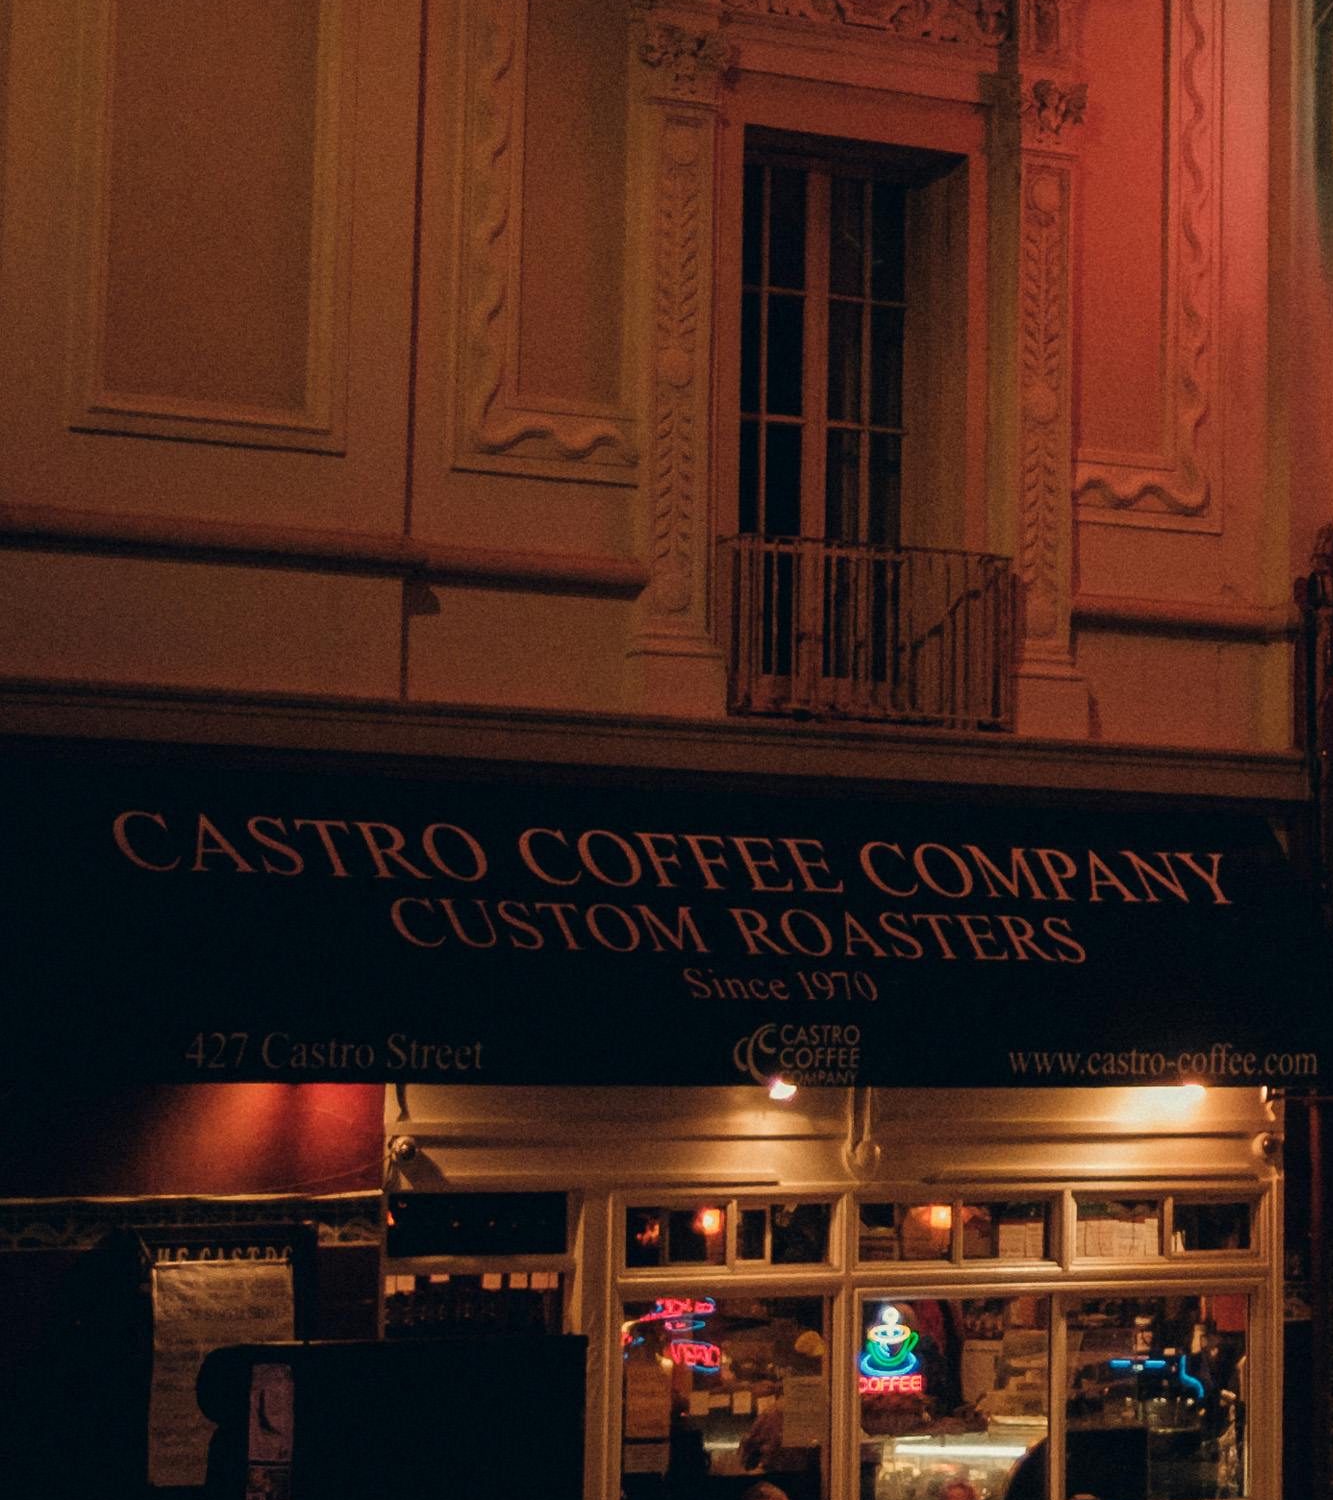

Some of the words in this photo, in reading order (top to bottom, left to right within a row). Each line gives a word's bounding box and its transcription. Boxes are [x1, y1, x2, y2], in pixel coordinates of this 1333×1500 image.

[112, 809, 489, 883] CASTRO
[517, 826, 844, 893] COFFEE
[859, 840, 1233, 905] COMPANY
[390, 896, 711, 953] CUSTOM
[730, 905, 1086, 965] ROASTERS
[682, 966, 790, 1000] Since
[797, 969, 880, 1002] 1970
[184, 1031, 250, 1070] 427
[261, 1031, 376, 1071] Castro
[385, 1032, 484, 1072] Street
[780, 1023, 861, 1046] CASTRO
[780, 1047, 860, 1070] COFFEE
[1008, 1042, 1319, 1078] www.castro-coffee.com
[858, 1374, 923, 1394] COFFEE
